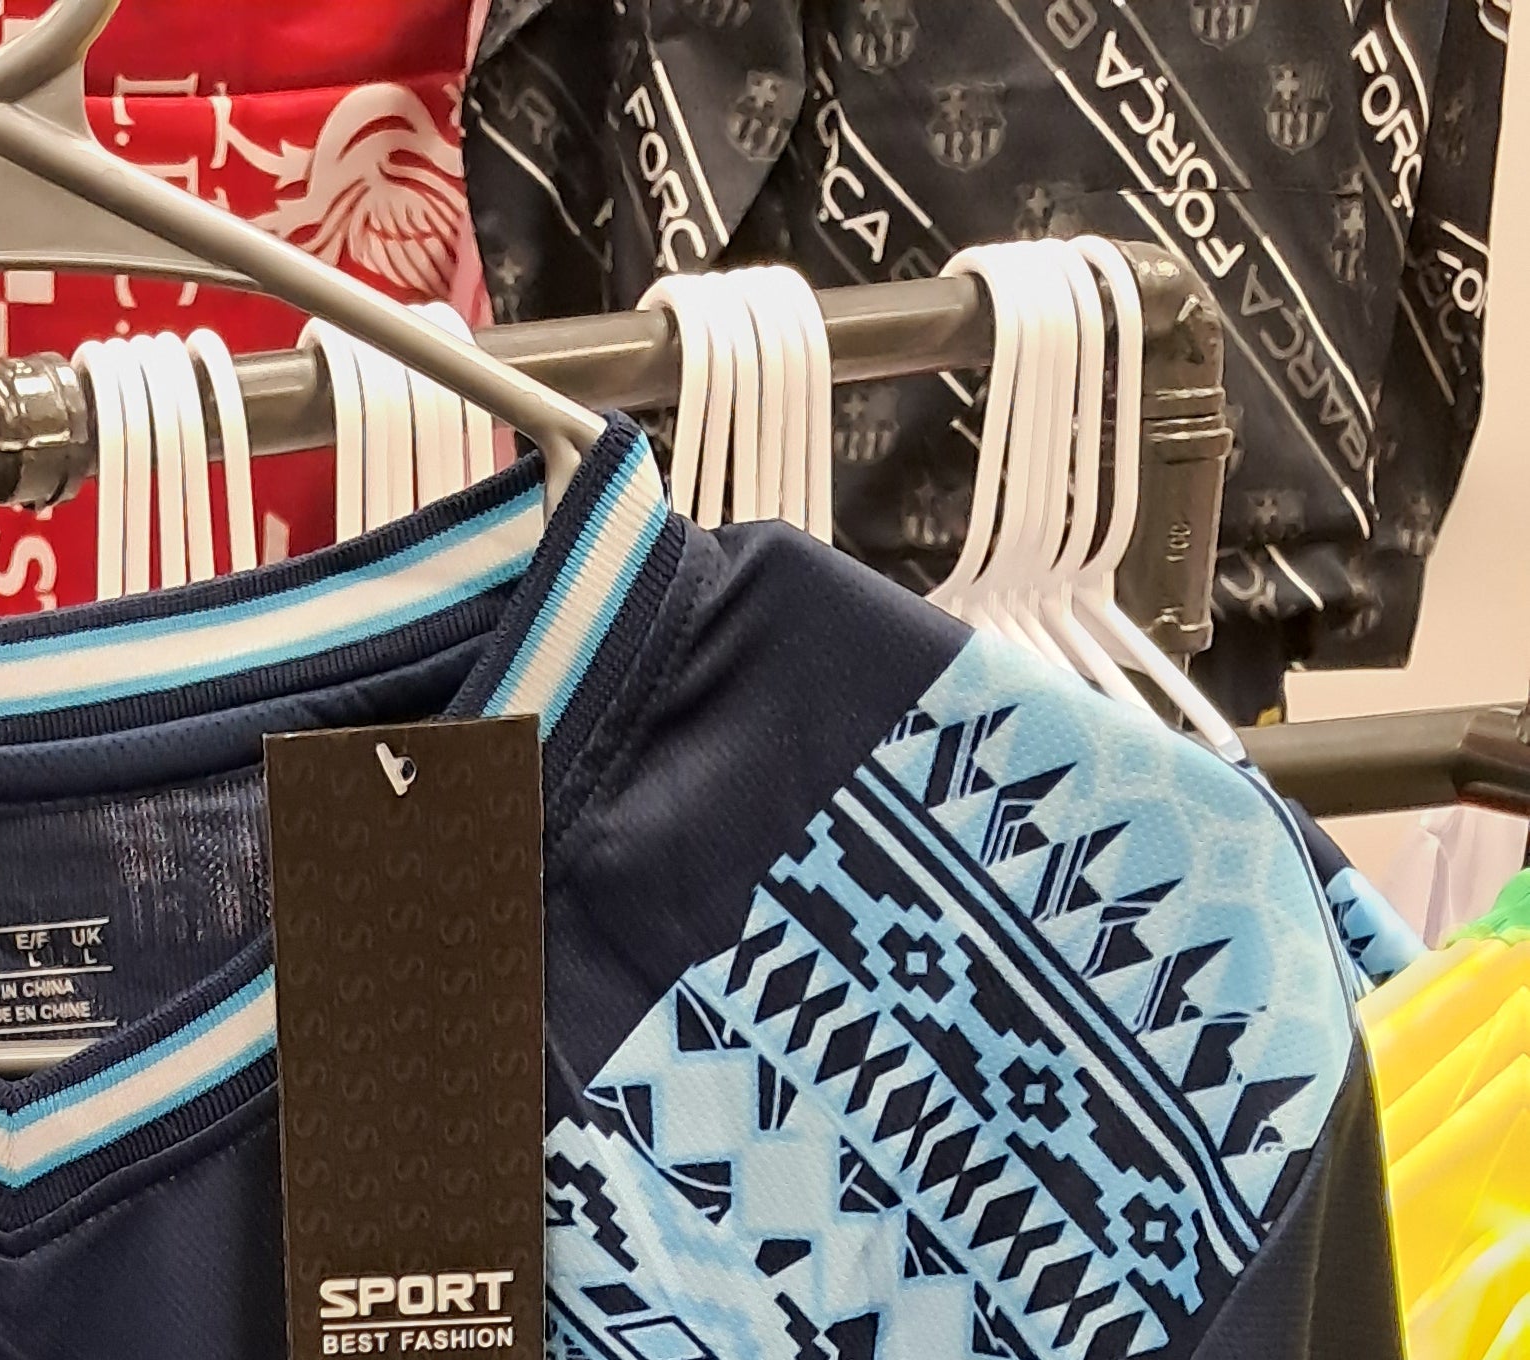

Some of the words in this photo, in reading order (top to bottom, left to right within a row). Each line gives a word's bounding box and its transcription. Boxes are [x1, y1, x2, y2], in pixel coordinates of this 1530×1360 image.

[71, 926, 103, 946] UK
[28, 950, 42, 968] L
[82, 946, 98, 965] L
[1, 980, 18, 1000] IN
[22, 979, 75, 998] CHINA
[14, 1004, 37, 1022] EN
[39, 1001, 91, 1020] CHINE
[319, 1270, 515, 1318] SPORT
[323, 1332, 390, 1355] BEST
[400, 1326, 514, 1351] FASHION
